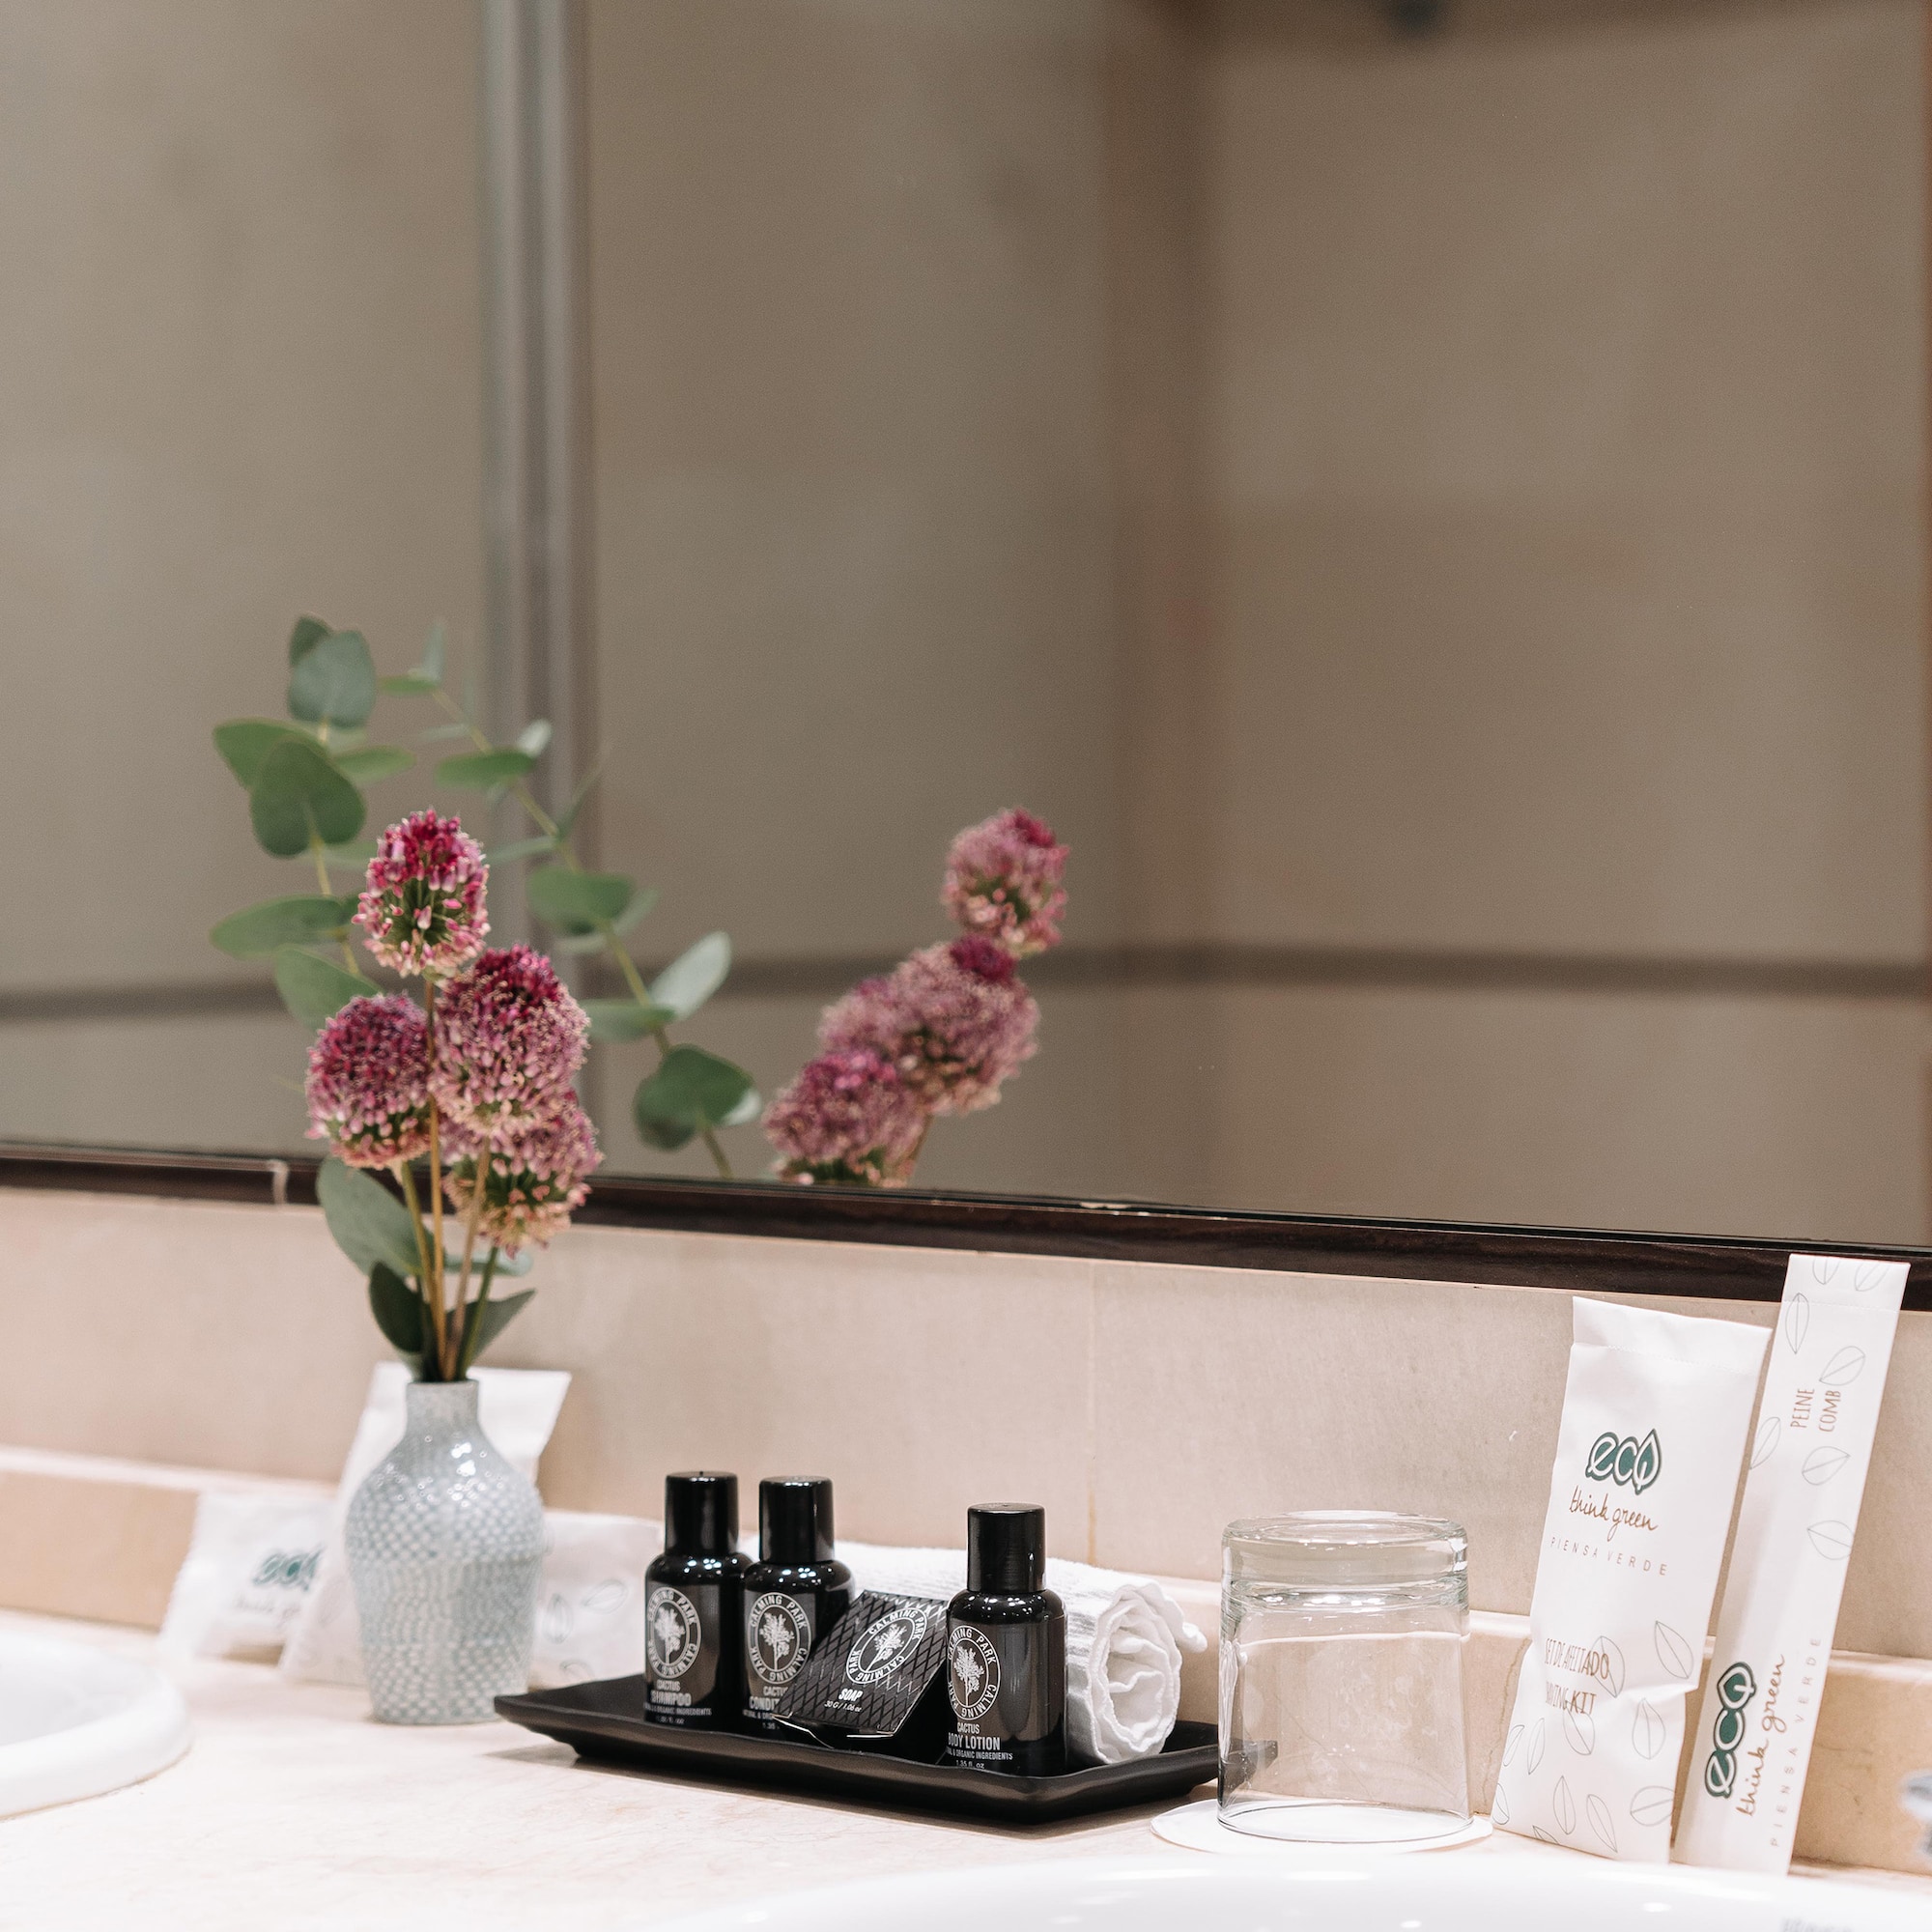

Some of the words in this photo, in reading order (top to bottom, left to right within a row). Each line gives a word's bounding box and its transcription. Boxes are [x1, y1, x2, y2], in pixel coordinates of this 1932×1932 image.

[1790, 1388, 1815, 1428] PEINE
[1819, 1390, 1841, 1432] COMB
[1570, 1485, 1608, 1521] think
[1607, 1507, 1659, 1542] green
[1550, 1536, 1599, 1559] PIENSA
[1607, 1550, 1668, 1577] VERDE
[751, 1595, 783, 1628] CALMING
[786, 1602, 809, 1630] PARK
[868, 1609, 919, 1634] CALMING
[911, 1616, 925, 1640] PARK
[751, 1647, 767, 1674] PARK
[848, 1649, 863, 1674] PARK
[948, 1628, 973, 1661] CALMING
[976, 1635, 997, 1665] PARK
[769, 1647, 808, 1682] CALMING
[855, 1655, 906, 1682] CALMING
[657, 1679, 681, 1692] CACTUS
[838, 1689, 863, 1702] SOAP
[961, 1684, 997, 1719] CALMING
[1570, 1690, 1597, 1716] KIT
[948, 1732, 964, 1748] BODY
[965, 1735, 1001, 1750] LOTION
[956, 1721, 980, 1735] CACTUS
[1737, 1739, 1769, 1816] think
[1762, 1654, 1787, 1733] green
[1771, 1747, 1799, 1847] PIENSA
[1795, 1638, 1821, 1723] VERDE
[955, 1748, 976, 1759] ORGANIC
[976, 1749, 1013, 1761] INGREDIENTS
